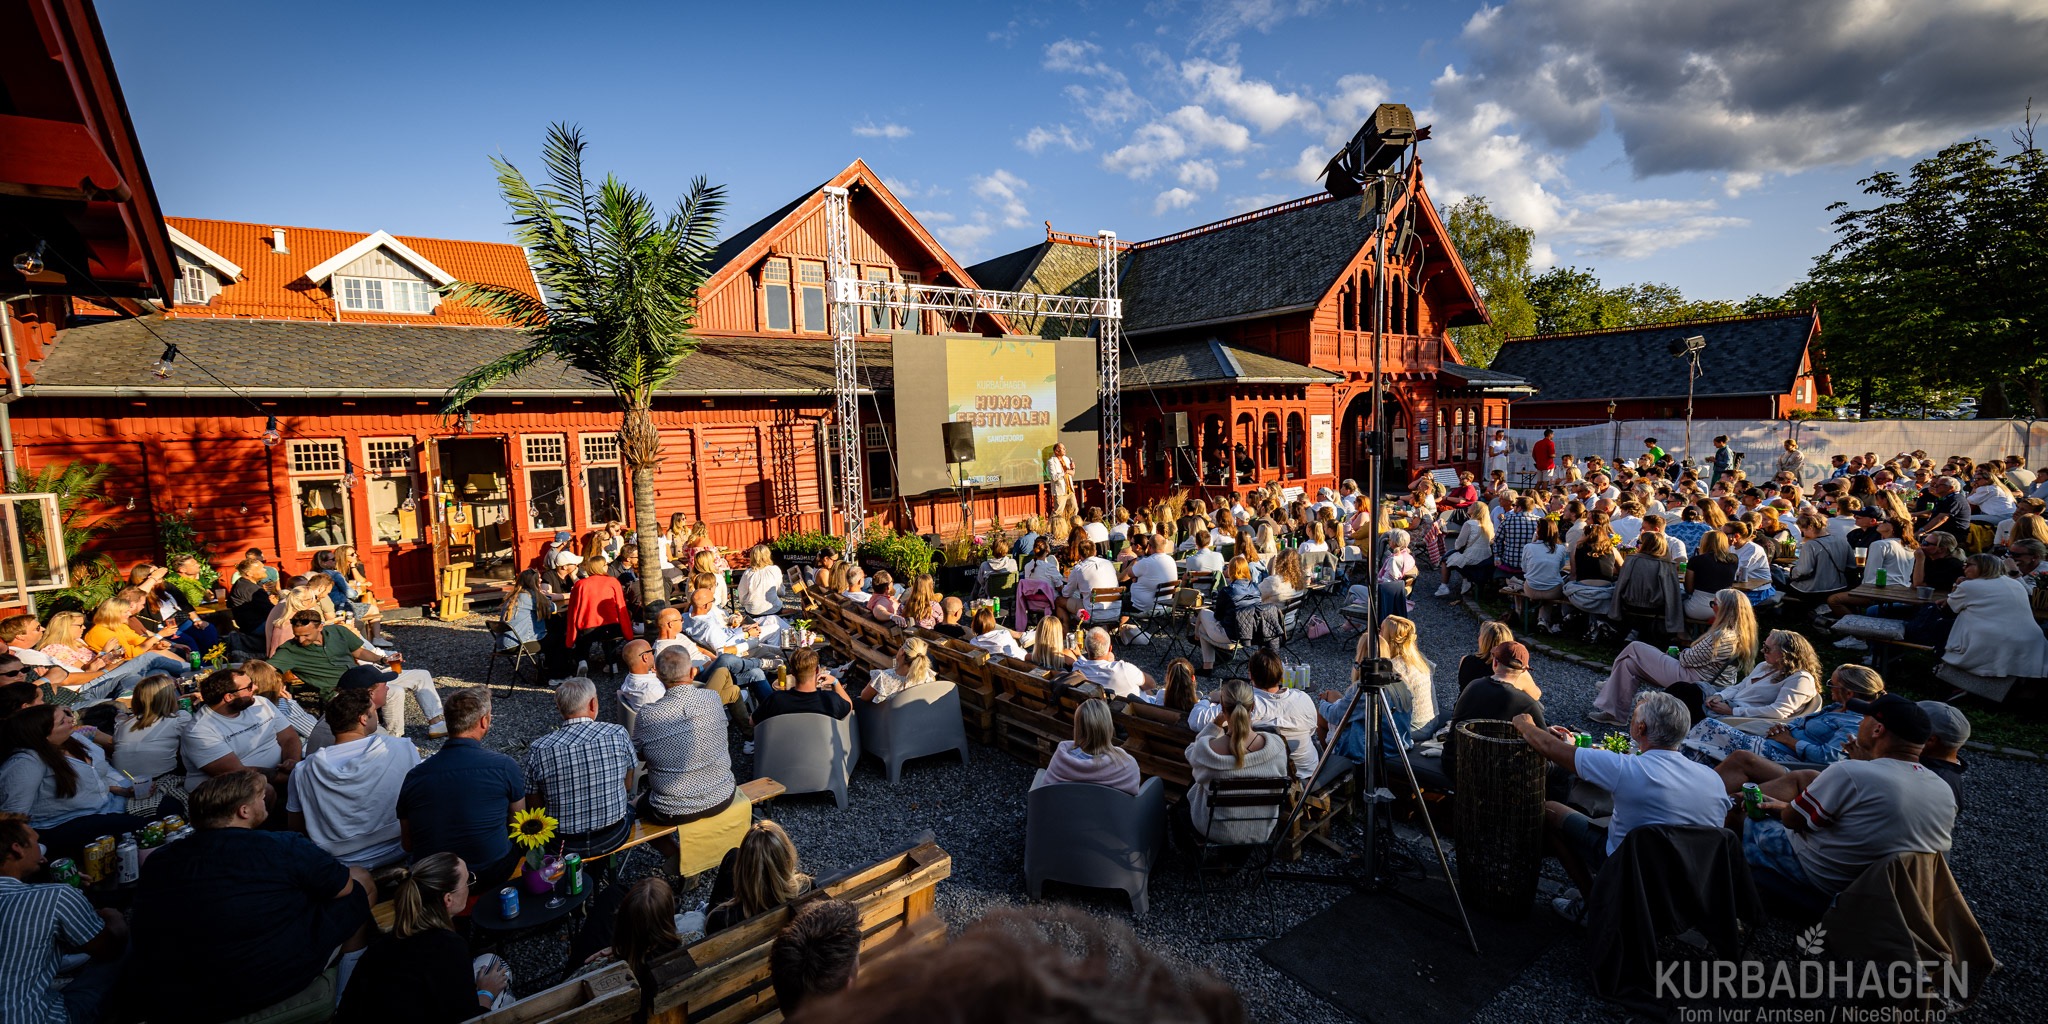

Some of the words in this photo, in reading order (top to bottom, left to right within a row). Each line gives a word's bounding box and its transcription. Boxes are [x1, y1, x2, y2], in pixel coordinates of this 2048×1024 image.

[976, 380, 1026, 390] KURBADHAGEN
[975, 395, 1032, 410] HUMOR
[955, 411, 1050, 427] FESTIVALEN
